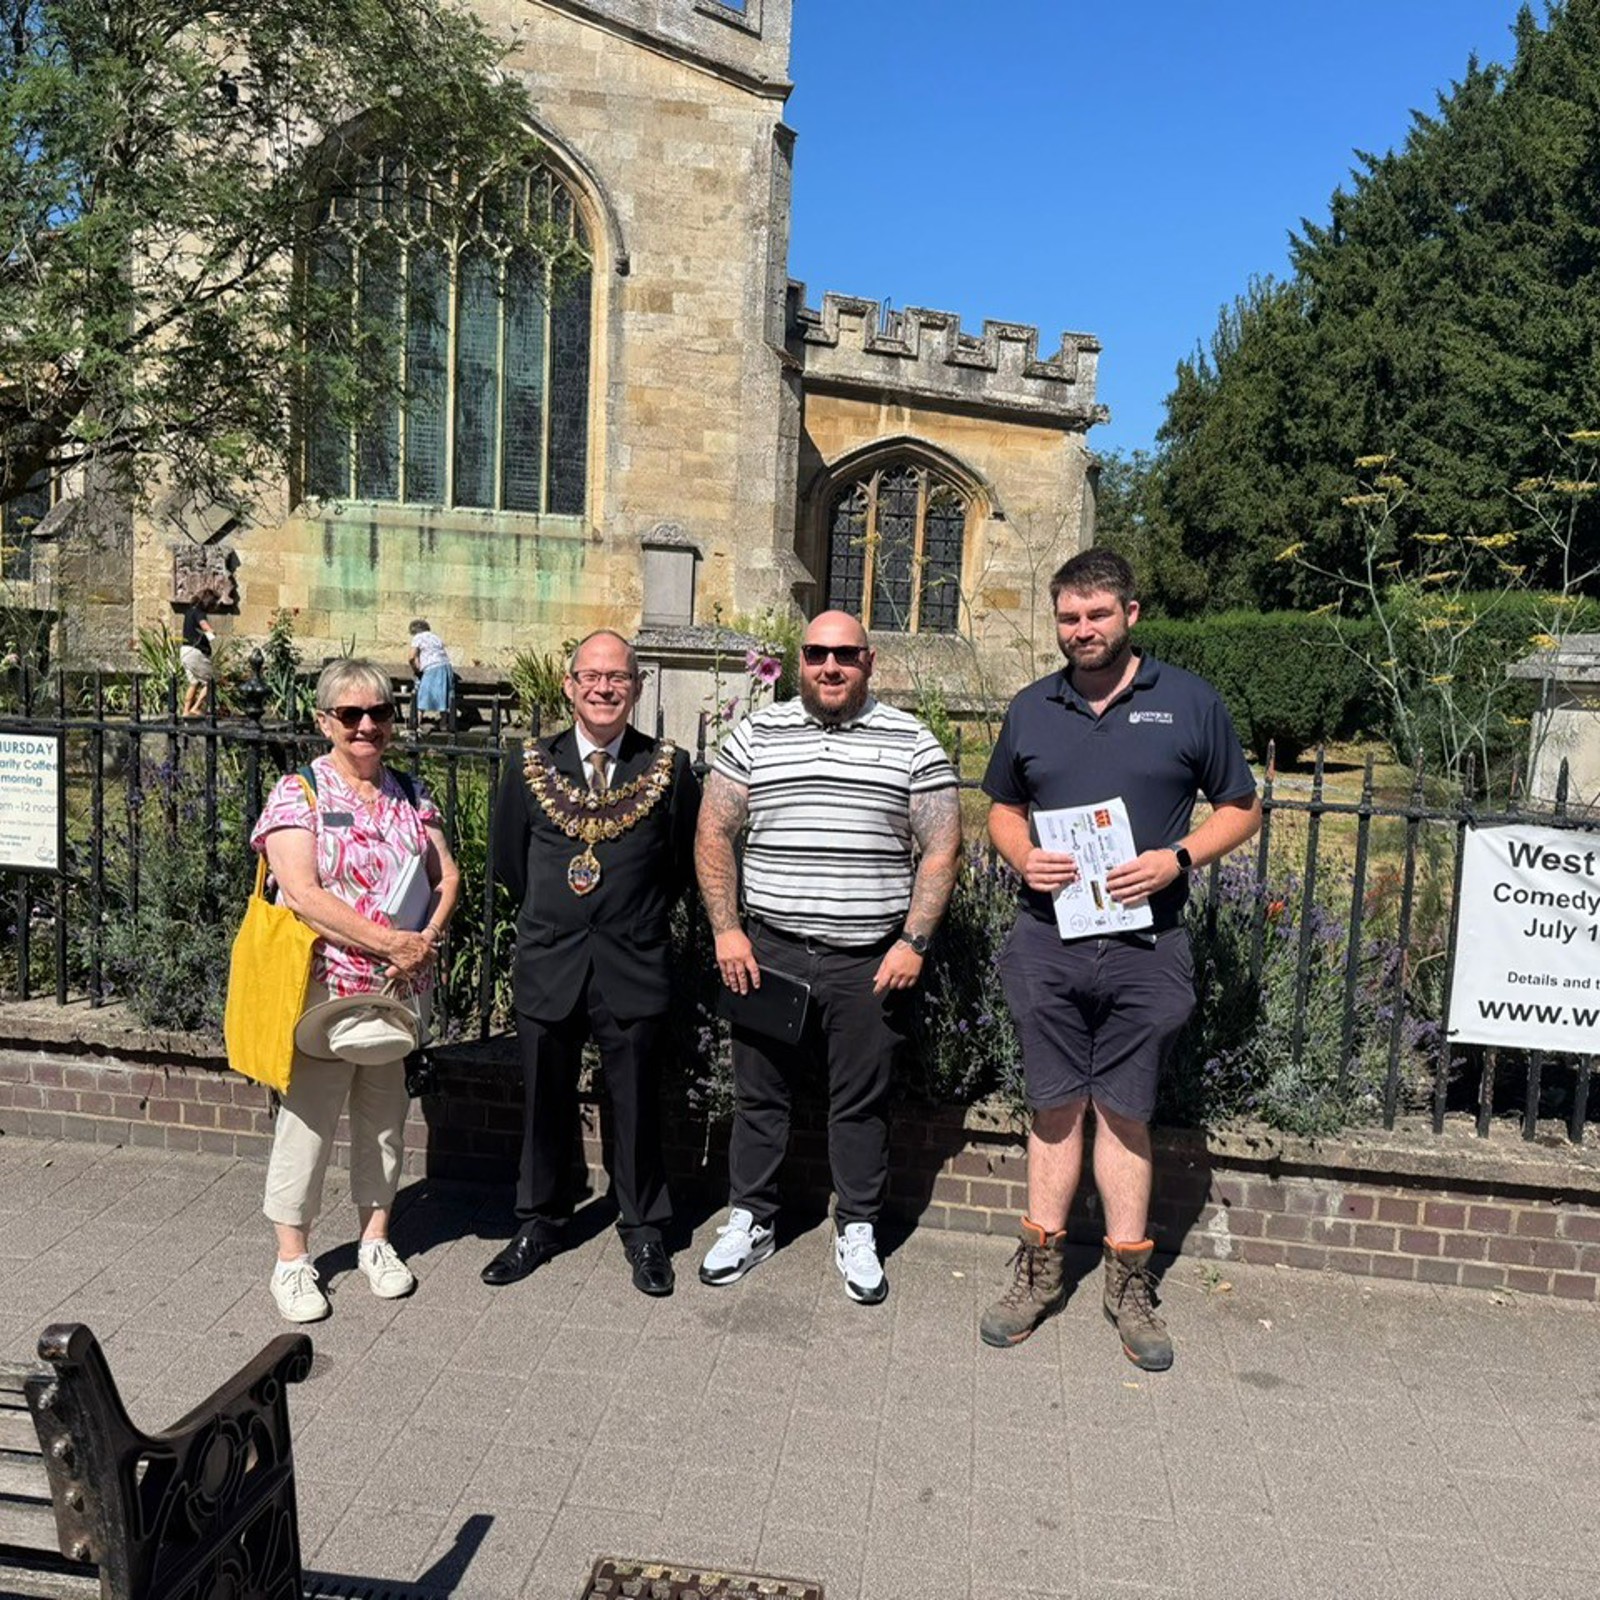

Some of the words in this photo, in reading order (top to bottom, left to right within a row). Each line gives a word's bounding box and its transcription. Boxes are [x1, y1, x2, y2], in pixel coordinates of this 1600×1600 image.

[0, 741, 54, 755] URSDAY
[1, 774, 42, 787] morning
[1508, 841, 1595, 876] West
[1493, 883, 1600, 916] Comedy
[1523, 918, 1577, 944] July
[1588, 924, 1598, 942] 1
[1507, 971, 1558, 987] Details
[1563, 978, 1591, 989] and
[1478, 1000, 1600, 1027] www.w
